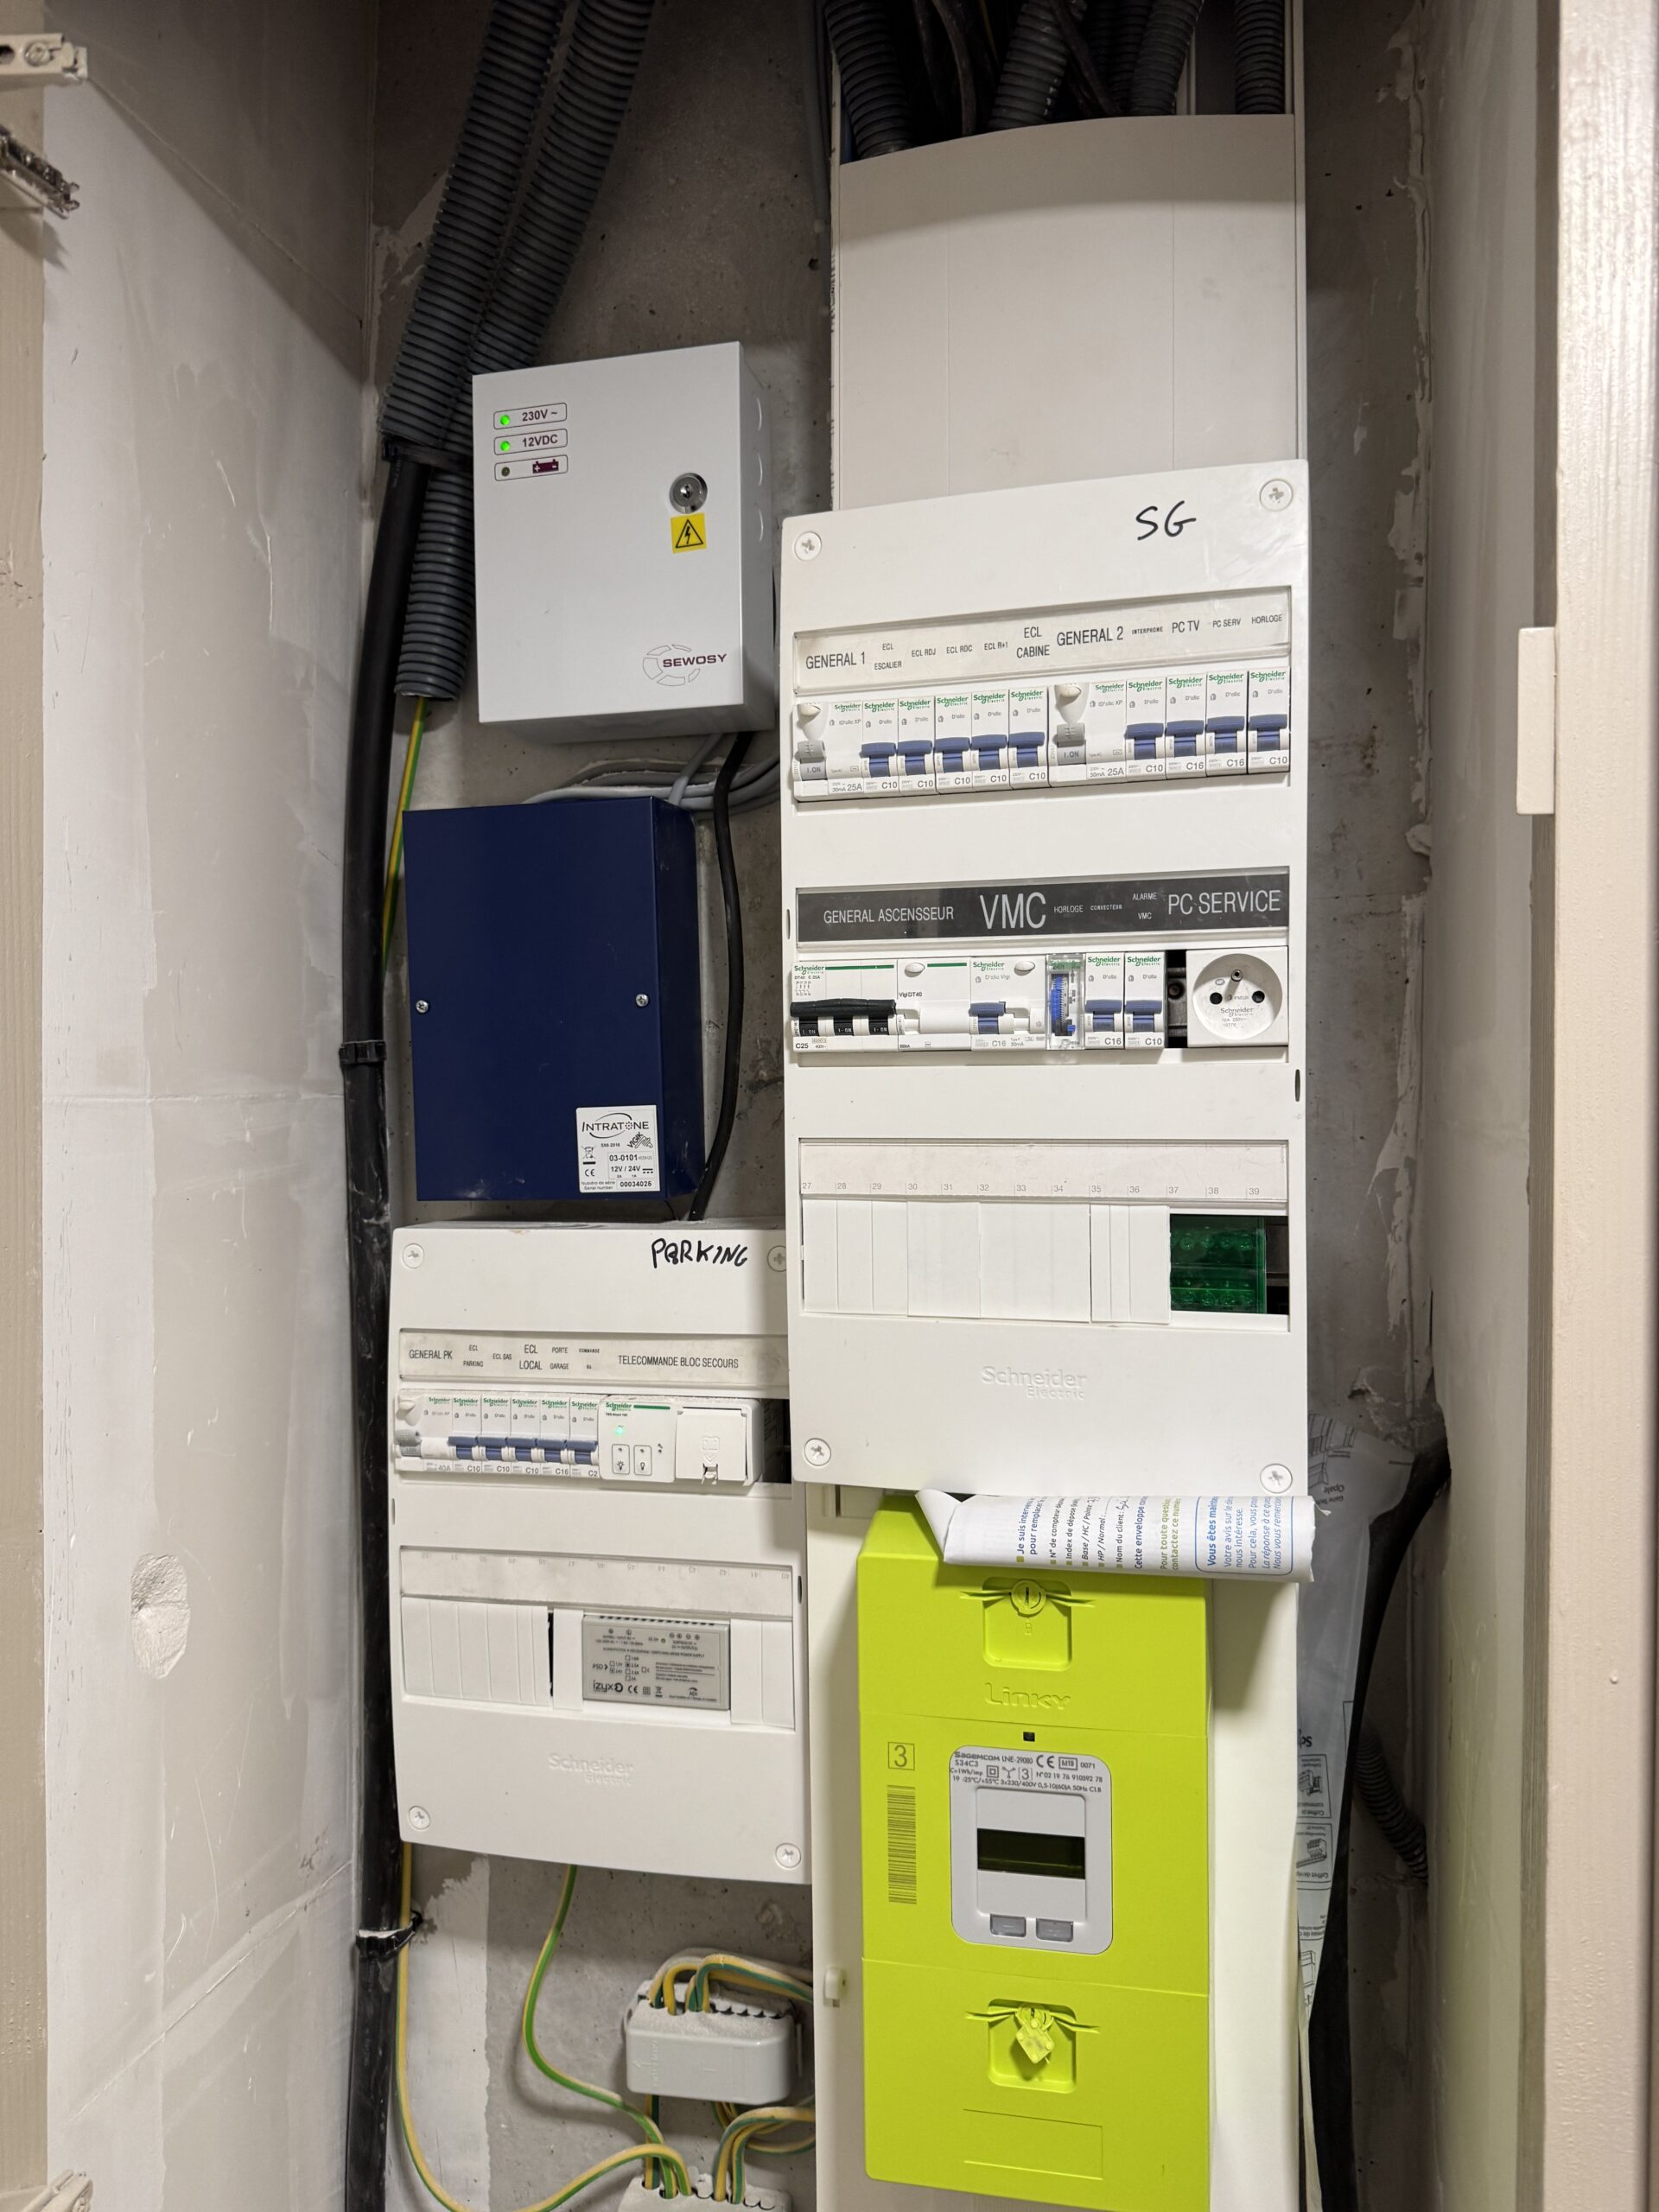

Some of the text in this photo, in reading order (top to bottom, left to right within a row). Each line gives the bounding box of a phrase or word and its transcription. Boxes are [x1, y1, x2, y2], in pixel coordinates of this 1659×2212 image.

[522, 409, 548, 422] 230V
[522, 434, 558, 448] 12VDC
[1135, 500, 1197, 540] SG
[1212, 618, 1241, 628] PC SERV
[1251, 613, 1282, 624] HORLOGE
[1172, 620, 1200, 633] PC TV
[1024, 626, 1042, 639] ECL
[1057, 626, 1124, 646] GENERAL 2
[946, 645, 973, 654] ECL RDC
[984, 642, 996, 651] ECL
[1016, 645, 1051, 658] CABINE
[912, 648, 936, 658] ECL RDJ
[663, 653, 727, 668] SEWOSY
[806, 652, 865, 670] GENERAL 1
[874, 661, 902, 671] ESCALIER
[1209, 672, 1244, 684] Schneider
[1250, 671, 1287, 682] Schneider
[1128, 679, 1163, 692] Schneider
[1168, 677, 1203, 688] Schneider
[1011, 690, 1043, 701] Schneider
[864, 701, 895, 712] Schneider
[937, 696, 969, 707] Schneider
[1185, 761, 1204, 771] C16
[1226, 758, 1244, 768] C16
[1269, 756, 1287, 766] C10
[1107, 767, 1124, 776] 25A
[1145, 763, 1163, 773] C10
[954, 777, 970, 785] C10
[990, 774, 1007, 783] C10
[1029, 772, 1046, 781] C10
[881, 780, 898, 790] C10
[917, 779, 933, 789] C10
[1132, 892, 1157, 900] ALARME
[1168, 890, 1281, 915] PC SERVICE
[979, 892, 1046, 930] VMC
[1053, 905, 1084, 913] HORLOGE
[823, 906, 954, 924] GENERAL ASCENSSEUR
[1138, 912, 1152, 920] VMC
[973, 961, 1005, 971] Schneider
[1087, 956, 1121, 966] Schneider
[1127, 956, 1161, 966] Schneider
[794, 964, 825, 975] Schneider
[582, 1122, 649, 1132] INTRATONE
[626, 1132, 644, 1149] VIGIK
[1249, 1187, 1259, 1196] 39
[409, 1349, 453, 1359] GENERAL PK
[524, 1344, 538, 1354] ECL
[519, 1360, 543, 1370] LOCAL
[618, 1354, 739, 1370] TELECOMMANDE BLOC SECOURS
[981, 1365, 1088, 1389] Schneider
[1027, 1385, 1085, 1401] Electric
[606, 1402, 632, 1412] Schneider
[1135, 1506, 1145, 1546] enveloppe
[1172, 1518, 1179, 1528] ce
[1065, 1528, 1072, 1537] de
[1082, 1525, 1089, 1536] HC
[1224, 1526, 1232, 1542] avis
[1049, 1538, 1056, 1548] de
[1116, 1534, 1122, 1544] du
[1017, 1544, 1025, 1554] Je
[1160, 1524, 1168, 1570] Pour toute
[1262, 1525, 1272, 1569] La réponse
[1097, 1550, 1104, 1561] HP
[1207, 1543, 1217, 1567] Vous
[1224, 1544, 1232, 1567] Votre
[1249, 1550, 1257, 1568] Pour
[1273, 1550, 1281, 1569] Nous
[984, 1682, 1071, 1710] Linky
[893, 1745, 909, 1769] 3
